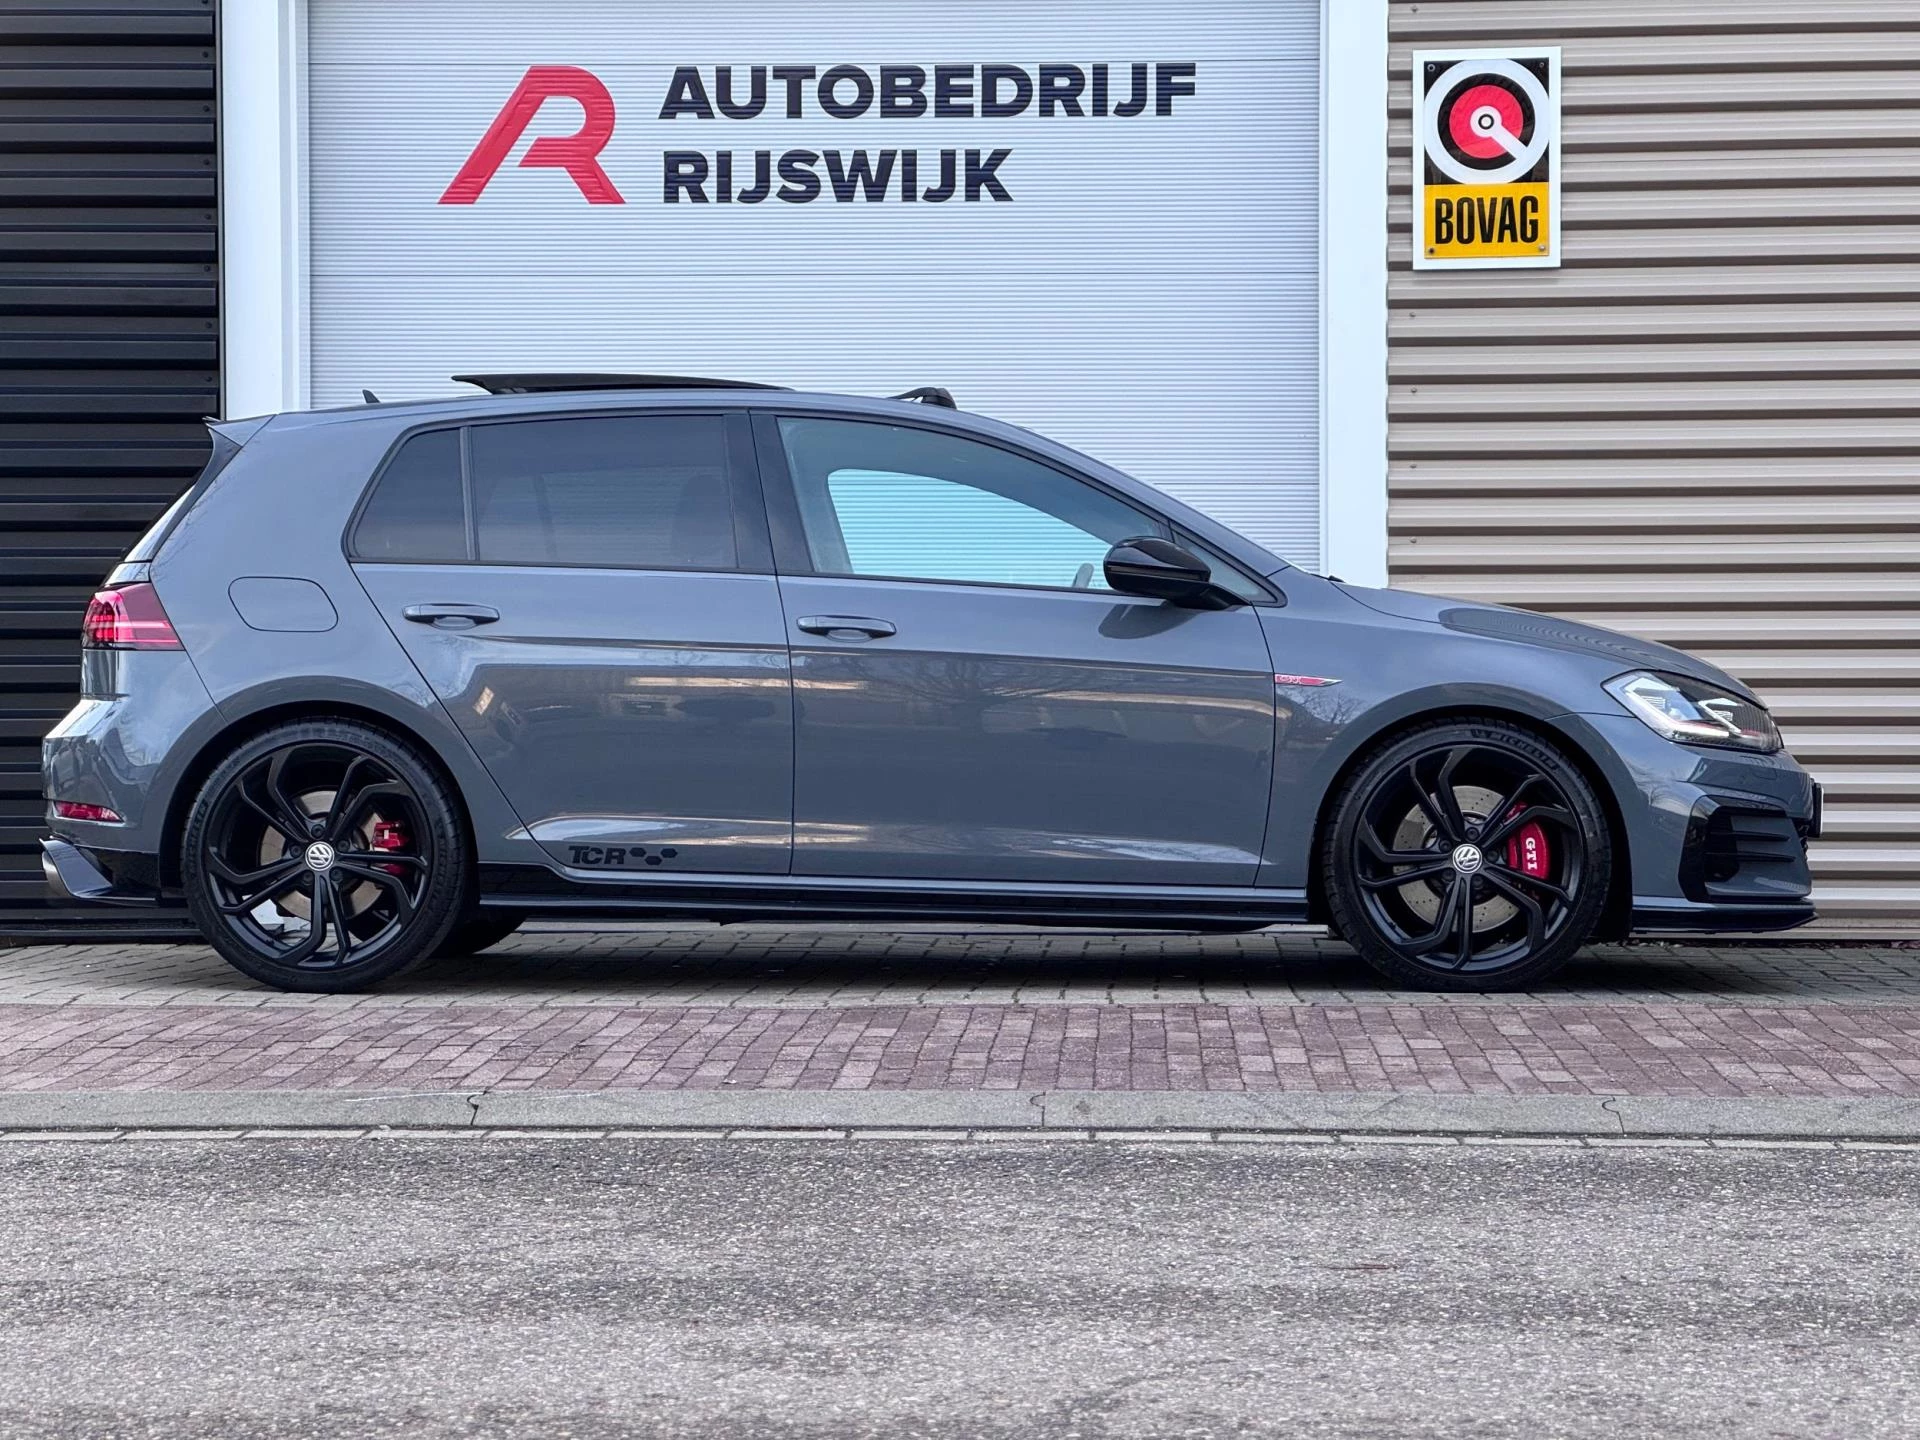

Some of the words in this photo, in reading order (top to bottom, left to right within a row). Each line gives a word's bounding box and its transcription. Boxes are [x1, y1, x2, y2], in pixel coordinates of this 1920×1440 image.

[658, 62, 1197, 119] AUTOBEDRIJF
[662, 148, 1014, 205] RIJSWIJK
[1434, 195, 1539, 245] BOVAG
[568, 845, 627, 865] TCR
[1525, 837, 1538, 870] GTI
